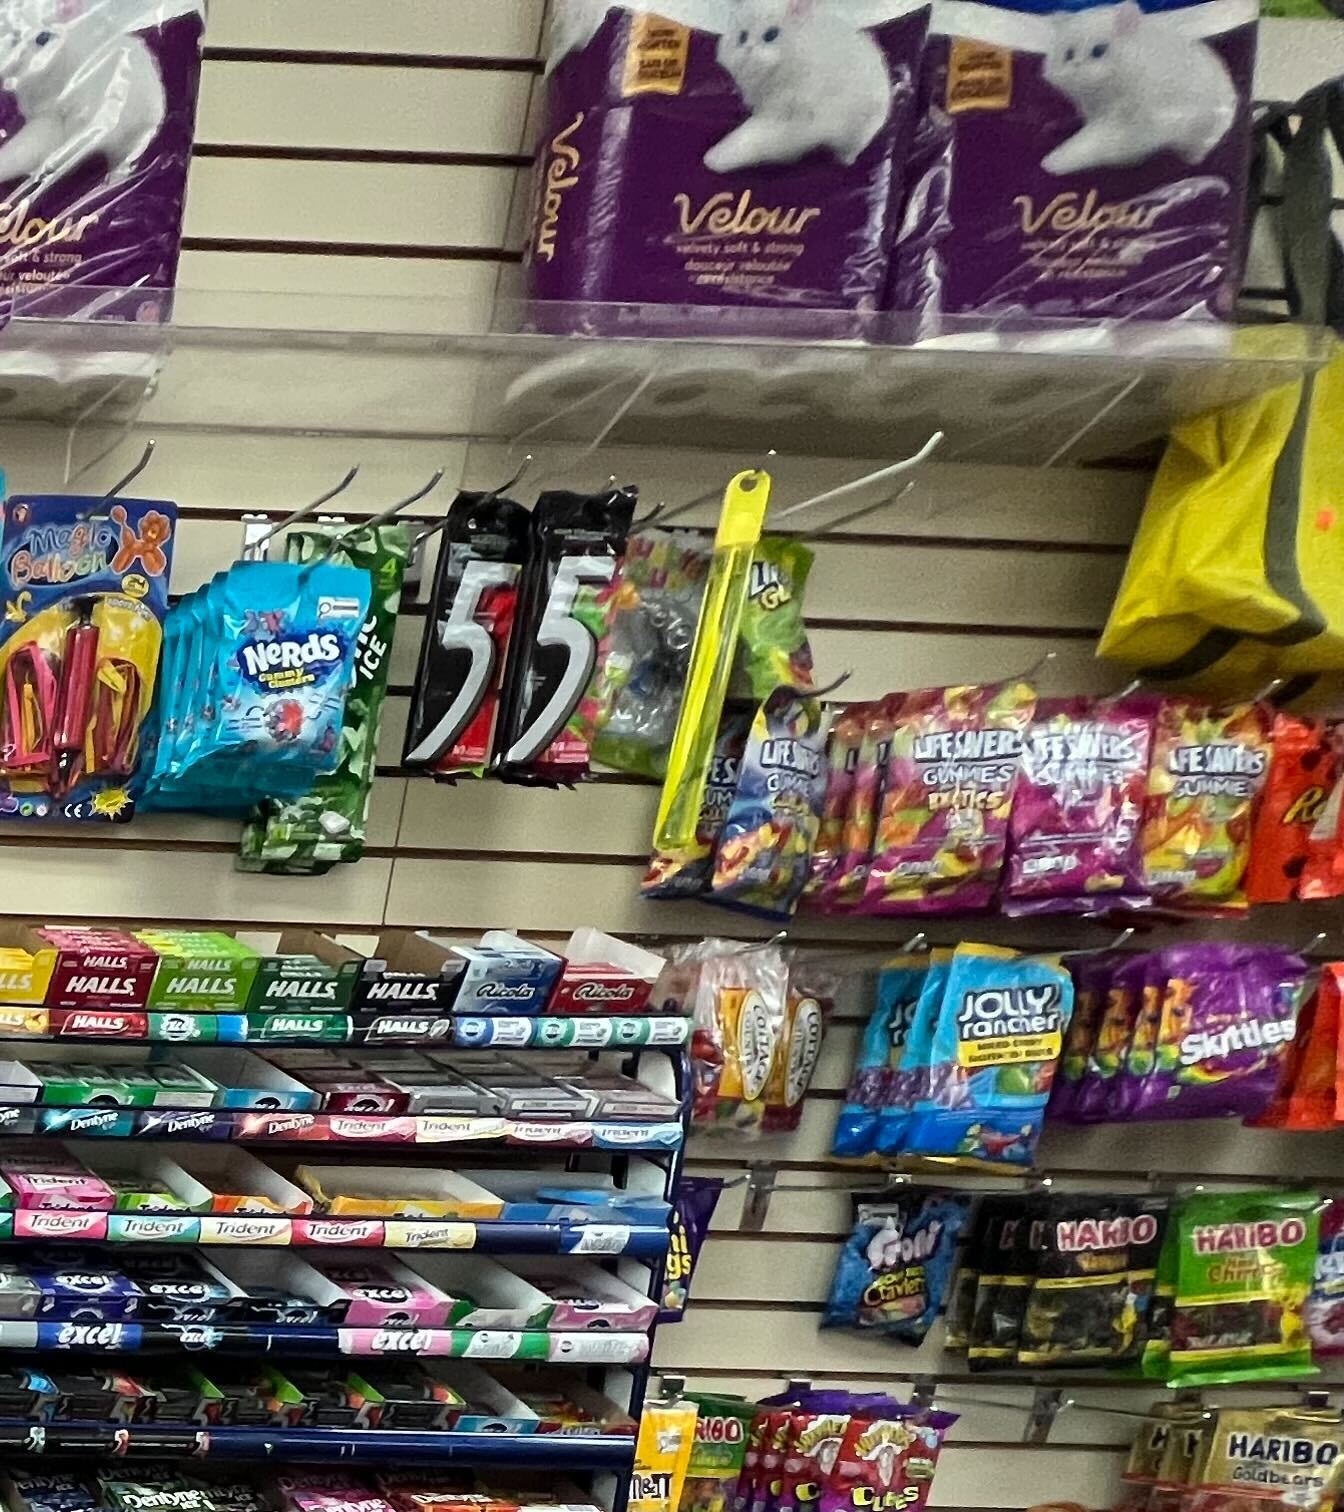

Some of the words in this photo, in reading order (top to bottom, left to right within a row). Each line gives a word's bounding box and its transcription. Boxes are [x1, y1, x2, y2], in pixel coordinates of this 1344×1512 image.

[674, 191, 822, 236] Velour
[359, 637, 387, 681] ICE
[406, 560, 522, 762] 5
[509, 555, 614, 762] 5
[65, 975, 135, 996] HALLS
[367, 982, 439, 1001] HALLS
[572, 982, 633, 1002] Ricola
[958, 984, 1059, 1020] JOLLY
[71, 1015, 124, 1031] HALLS
[961, 1014, 1060, 1039] rancher
[1181, 1018, 1296, 1066] Skittles
[70, 1111, 119, 1131] Dentyne
[124, 1220, 185, 1233] Trident
[215, 1221, 276, 1236] Trident
[309, 1222, 369, 1237] Trident
[1194, 1217, 1306, 1255] HARIBO
[694, 1416, 744, 1444] RIBO
[1229, 1433, 1339, 1465] HARIBO
[1233, 1466, 1324, 1488] Goldbears
